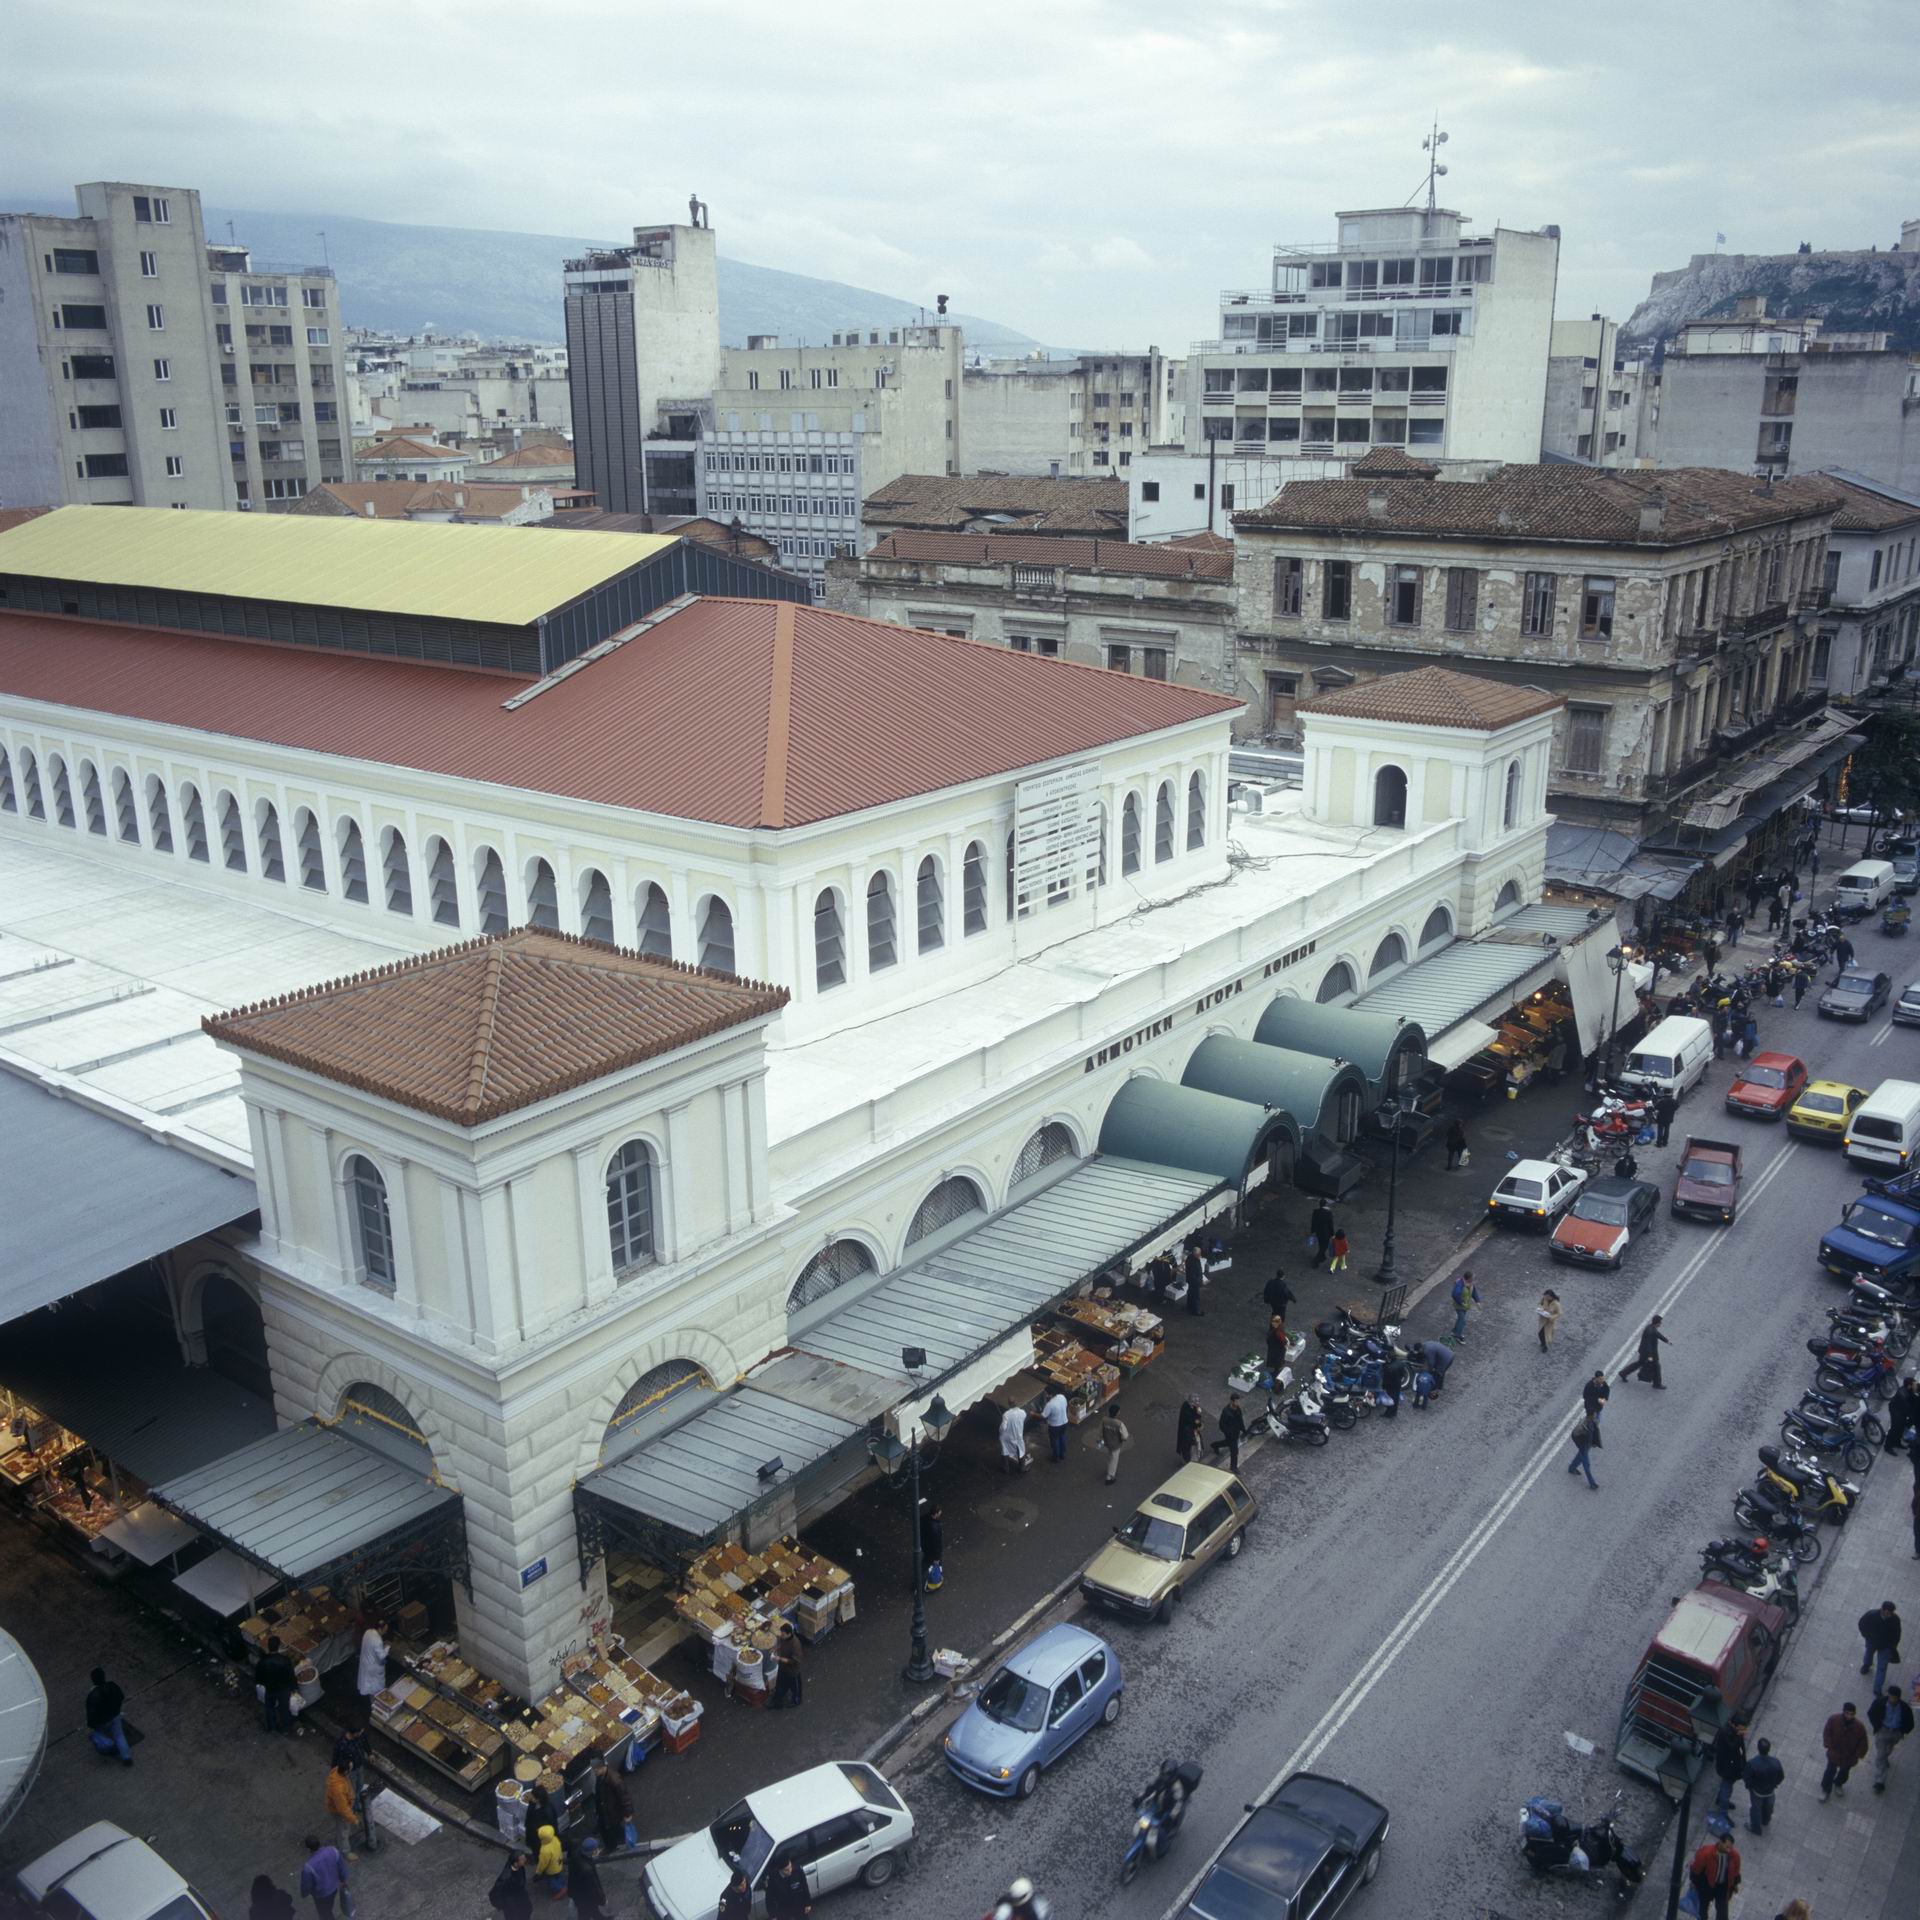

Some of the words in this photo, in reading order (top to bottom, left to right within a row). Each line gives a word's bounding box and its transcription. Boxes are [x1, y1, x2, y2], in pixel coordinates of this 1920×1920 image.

[1084, 1014, 1173, 1073] ΔΗΜΟΤΙΚΗ
[1196, 978, 1243, 1015] ΑΓΟΡΑ
[1263, 939, 1316, 979] ΑΘΗΝΩΝ
